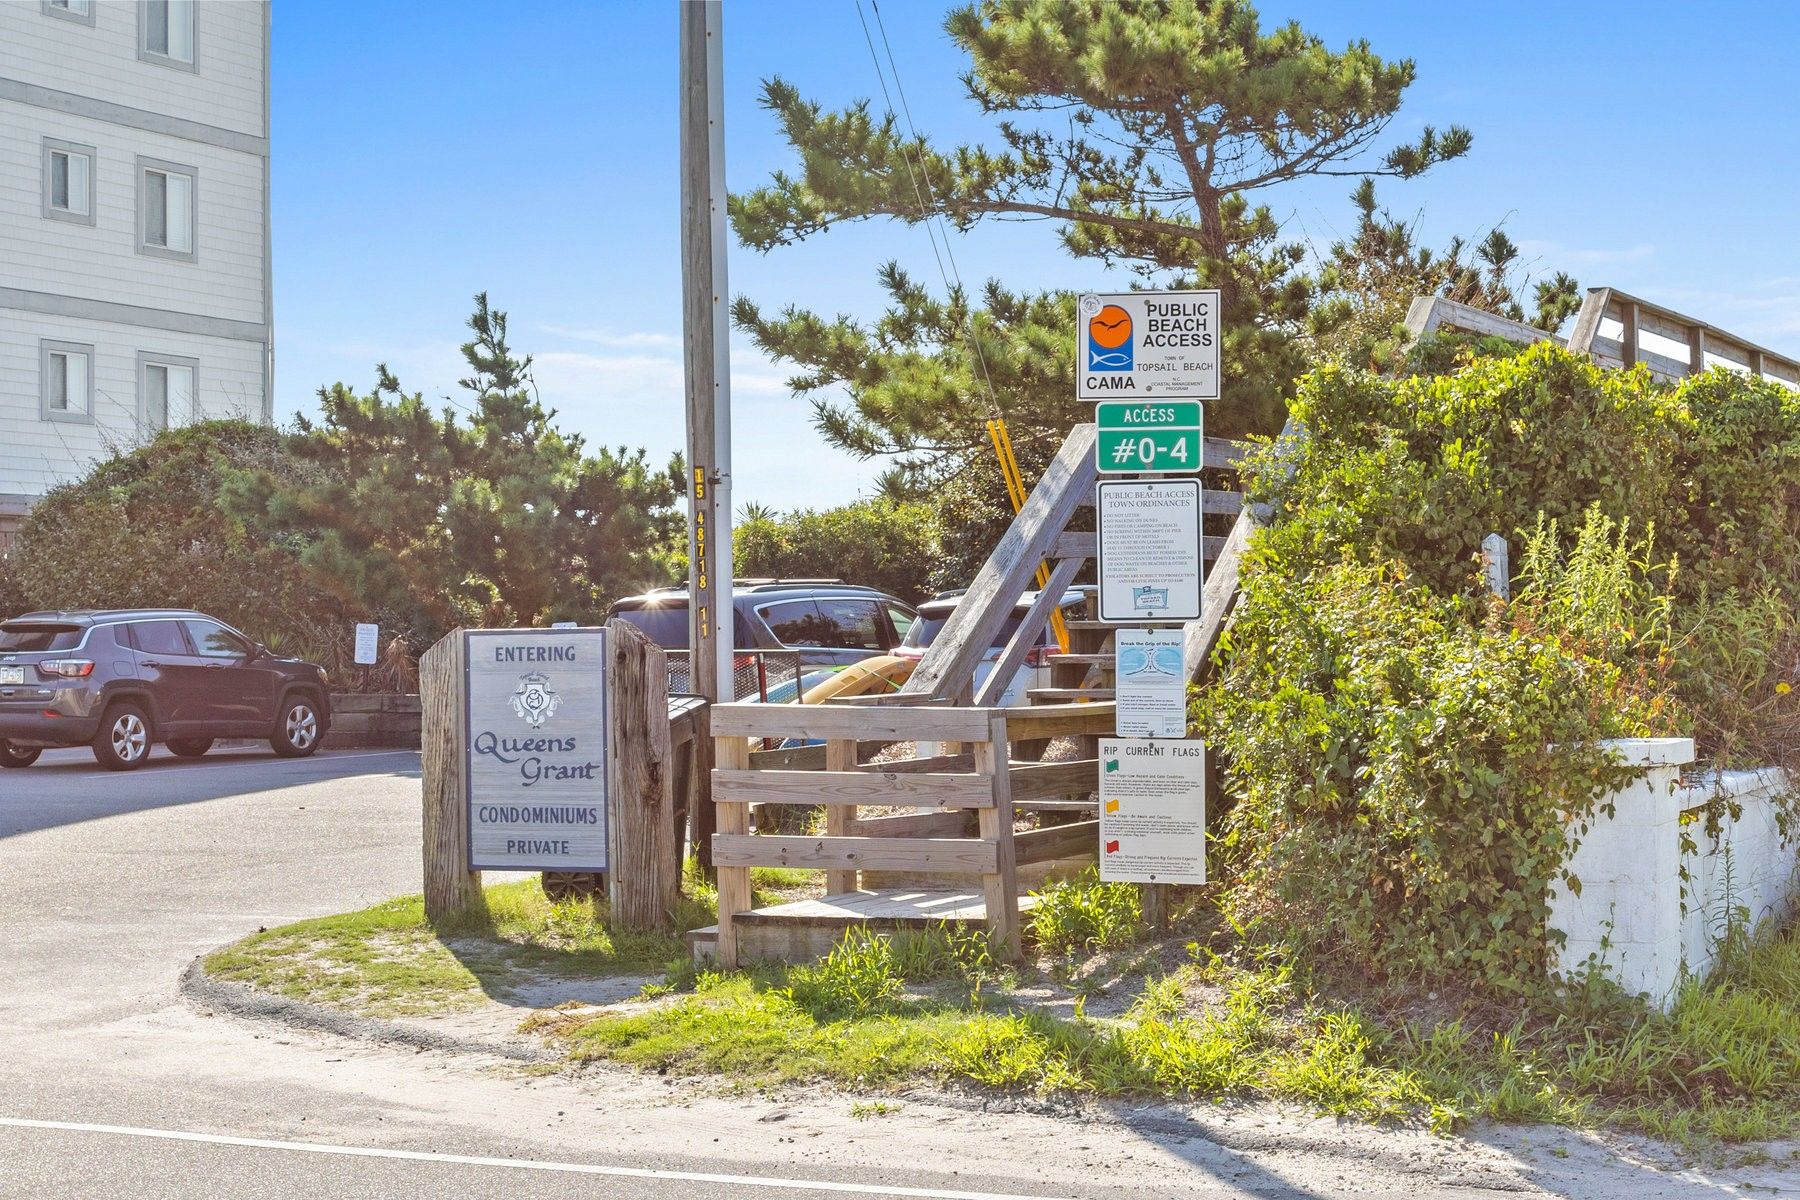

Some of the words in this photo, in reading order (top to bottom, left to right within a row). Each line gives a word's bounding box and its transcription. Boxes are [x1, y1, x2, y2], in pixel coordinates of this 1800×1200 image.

[1147, 303, 1209, 317] PUBLIC
[1148, 319, 1207, 332] BEACH
[1143, 333, 1213, 347] ACCESS
[1137, 362, 1178, 372] TOPSAIL
[1183, 362, 1213, 371] BEACH
[1086, 376, 1136, 390] CAMA
[1124, 408, 1175, 422] ACCESS
[1112, 437, 1188, 463] #0-4
[1136, 500, 1190, 508] ORDINANCES
[495, 646, 576, 662] ENTERING
[474, 731, 577, 764] Queens
[1104, 746, 1118, 755] RIP
[1126, 747, 1165, 756] CURRENT
[1172, 748, 1200, 757] FLAGS
[520, 757, 600, 787] Grant
[479, 806, 598, 824] CONDOMINIUMS
[507, 840, 570, 854] PRIVATE
